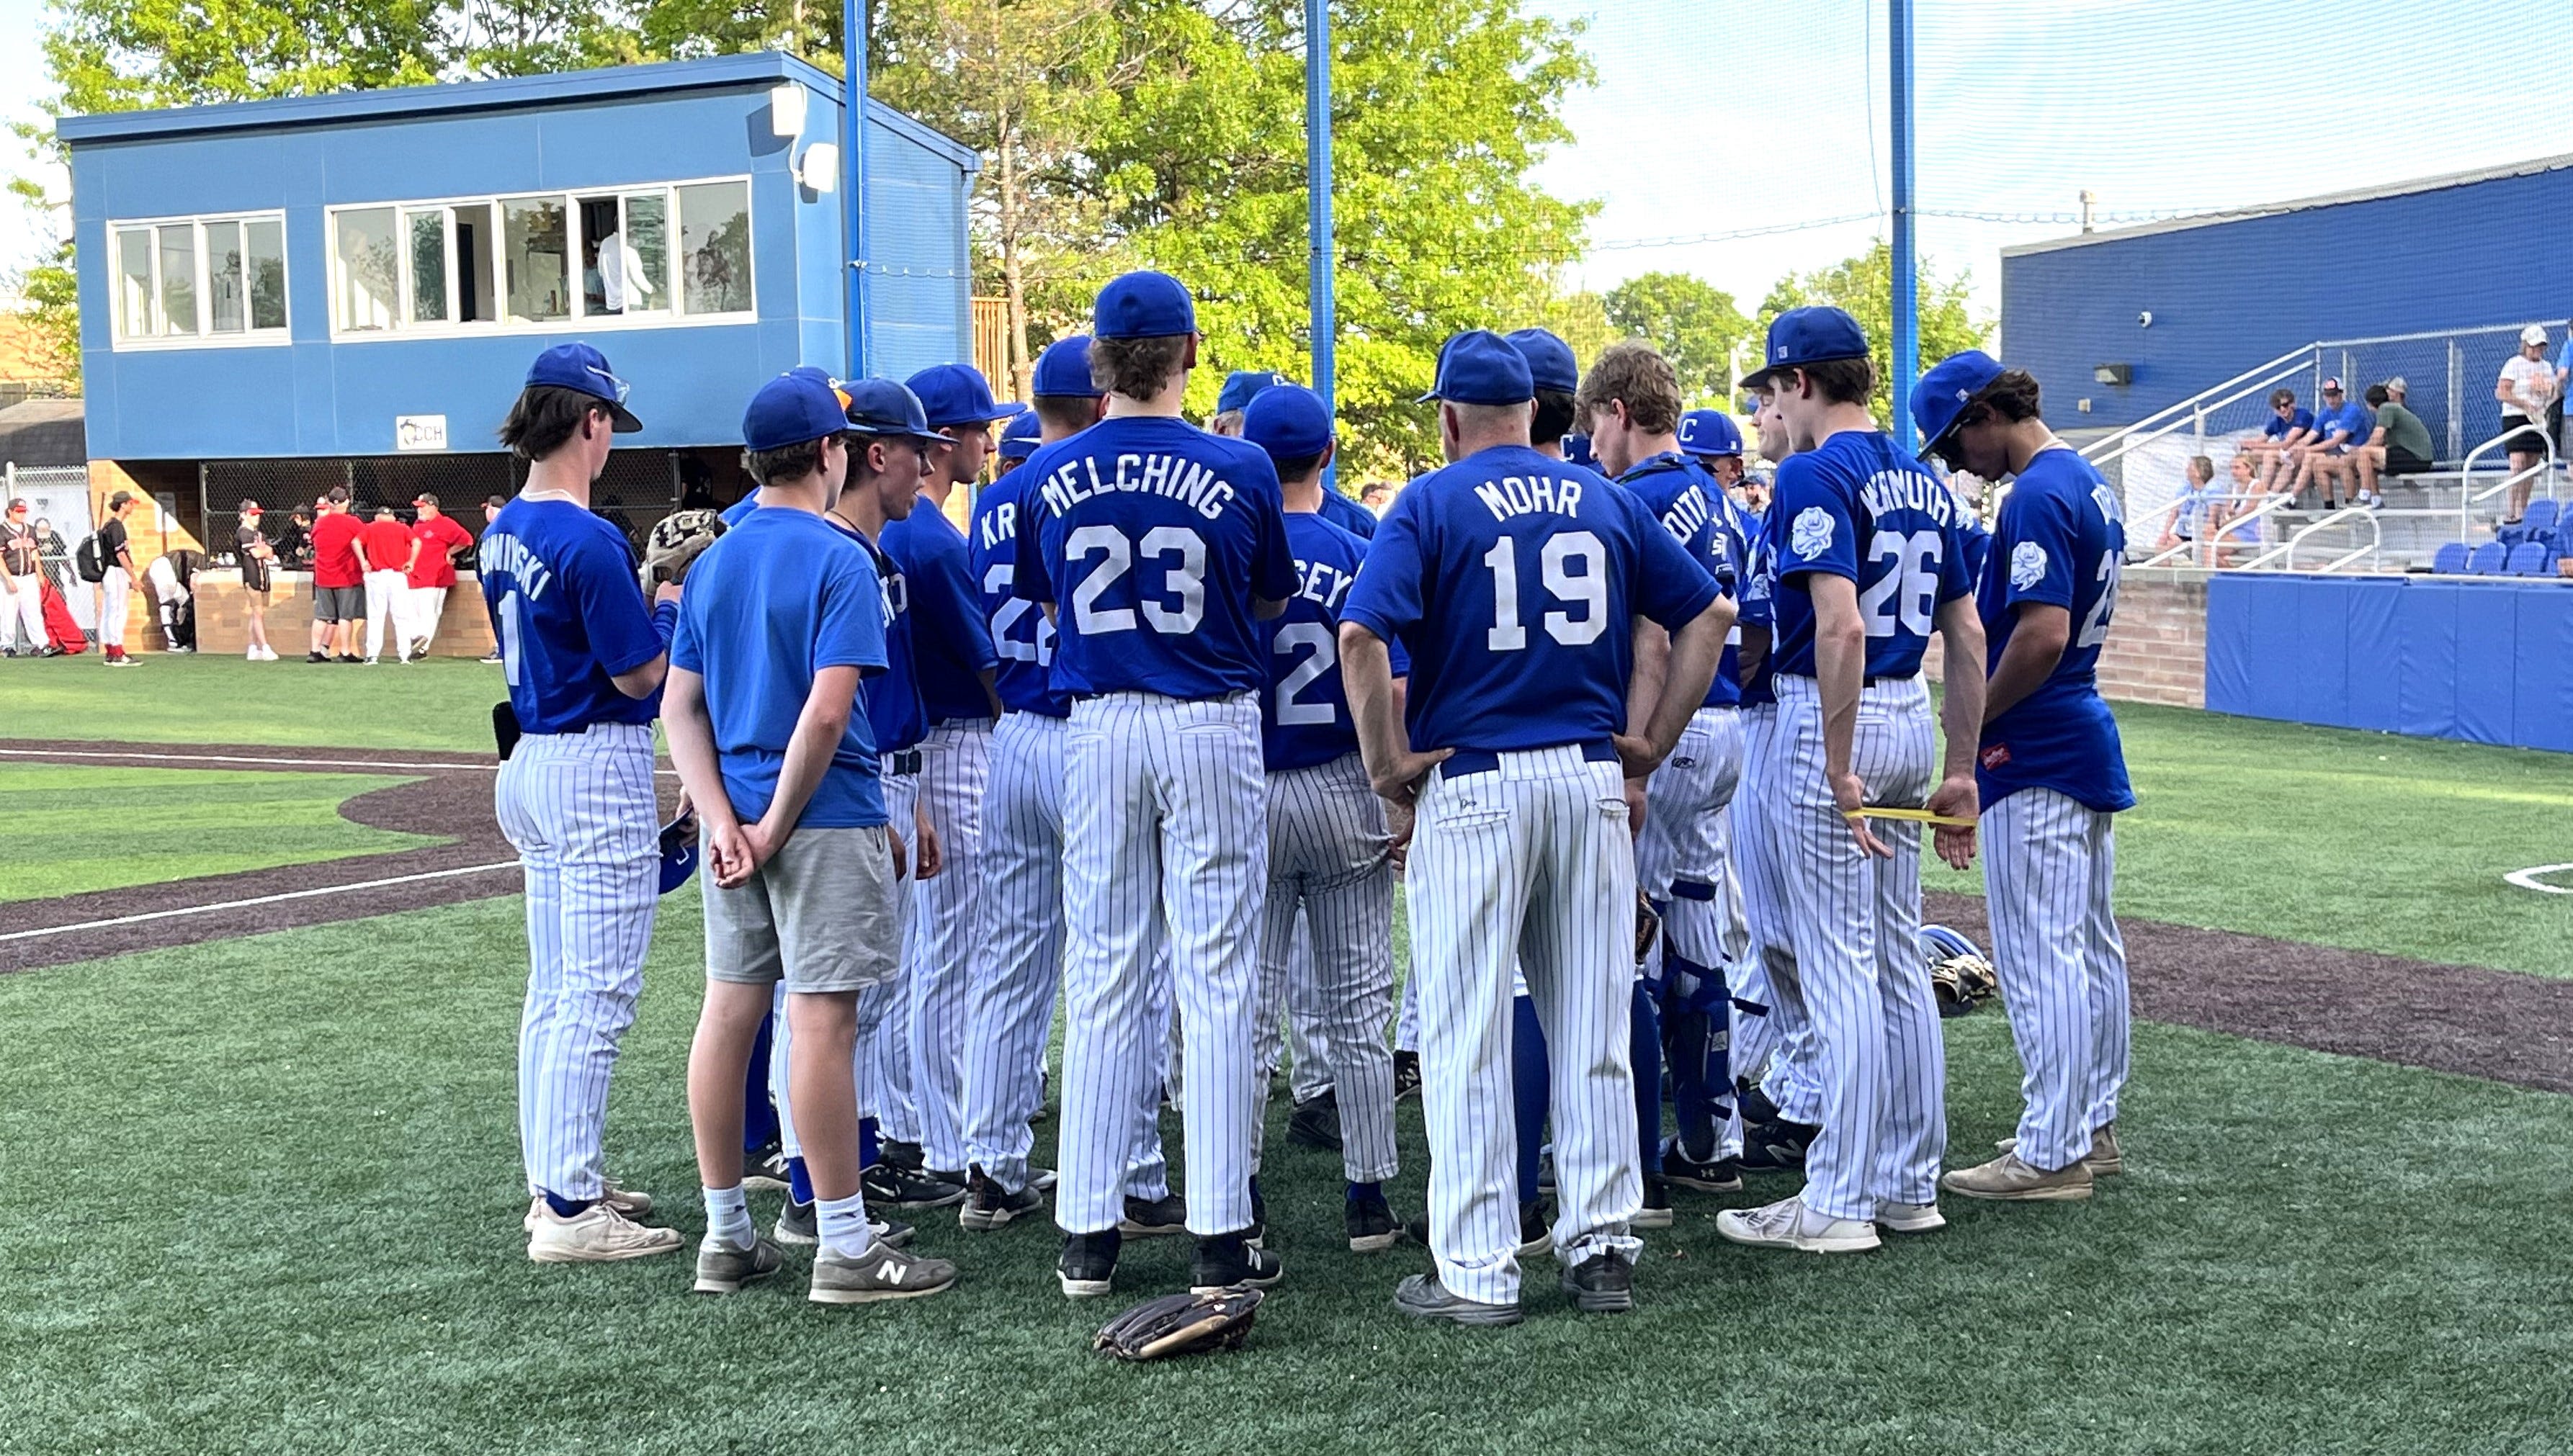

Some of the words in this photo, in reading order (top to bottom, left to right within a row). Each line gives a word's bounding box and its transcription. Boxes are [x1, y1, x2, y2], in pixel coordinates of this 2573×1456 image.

[1681, 419, 1698, 441] C
[981, 502, 1016, 550] KR
[1041, 454, 1234, 519] MELCHING
[1474, 475, 1582, 522] MOHR
[1065, 525, 1209, 634] 23
[1485, 531, 1607, 651] 19
[1859, 530, 1943, 637] 26
[1274, 622, 1335, 726] 2
